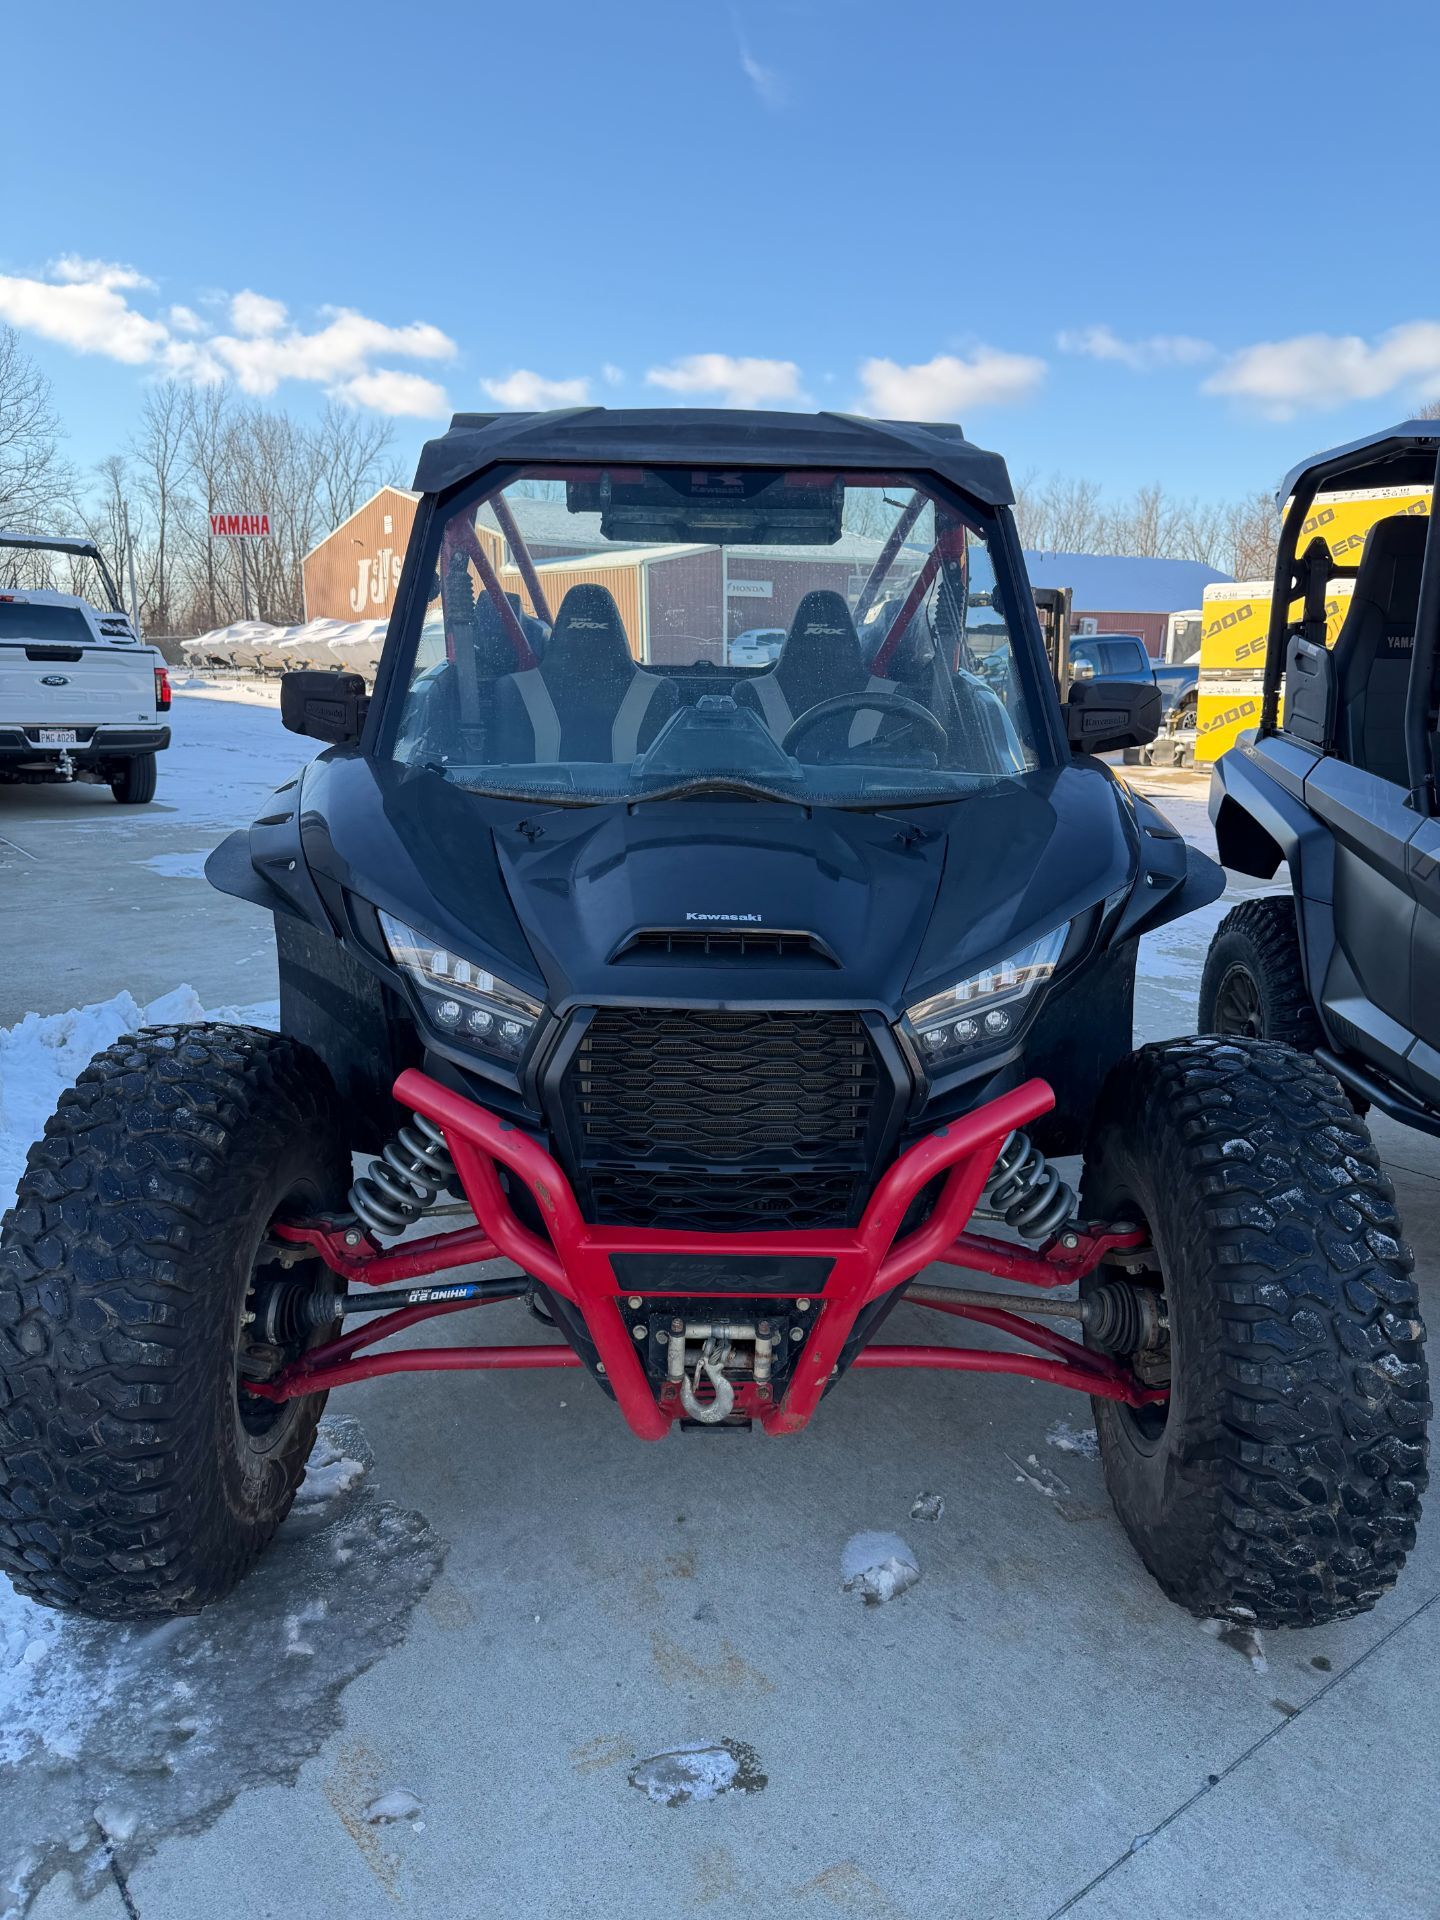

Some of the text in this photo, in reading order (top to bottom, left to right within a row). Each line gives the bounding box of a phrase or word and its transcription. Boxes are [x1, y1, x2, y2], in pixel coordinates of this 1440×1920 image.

[210, 515, 270, 535] YAMAHA
[1301, 508, 1335, 535] OO
[1387, 637, 1415, 648] YAMA
[1235, 636, 1268, 662] SE
[686, 913, 762, 922] Kawasaki
[409, 1293, 428, 1303] 2.0
[431, 1289, 467, 1300] RHINO
